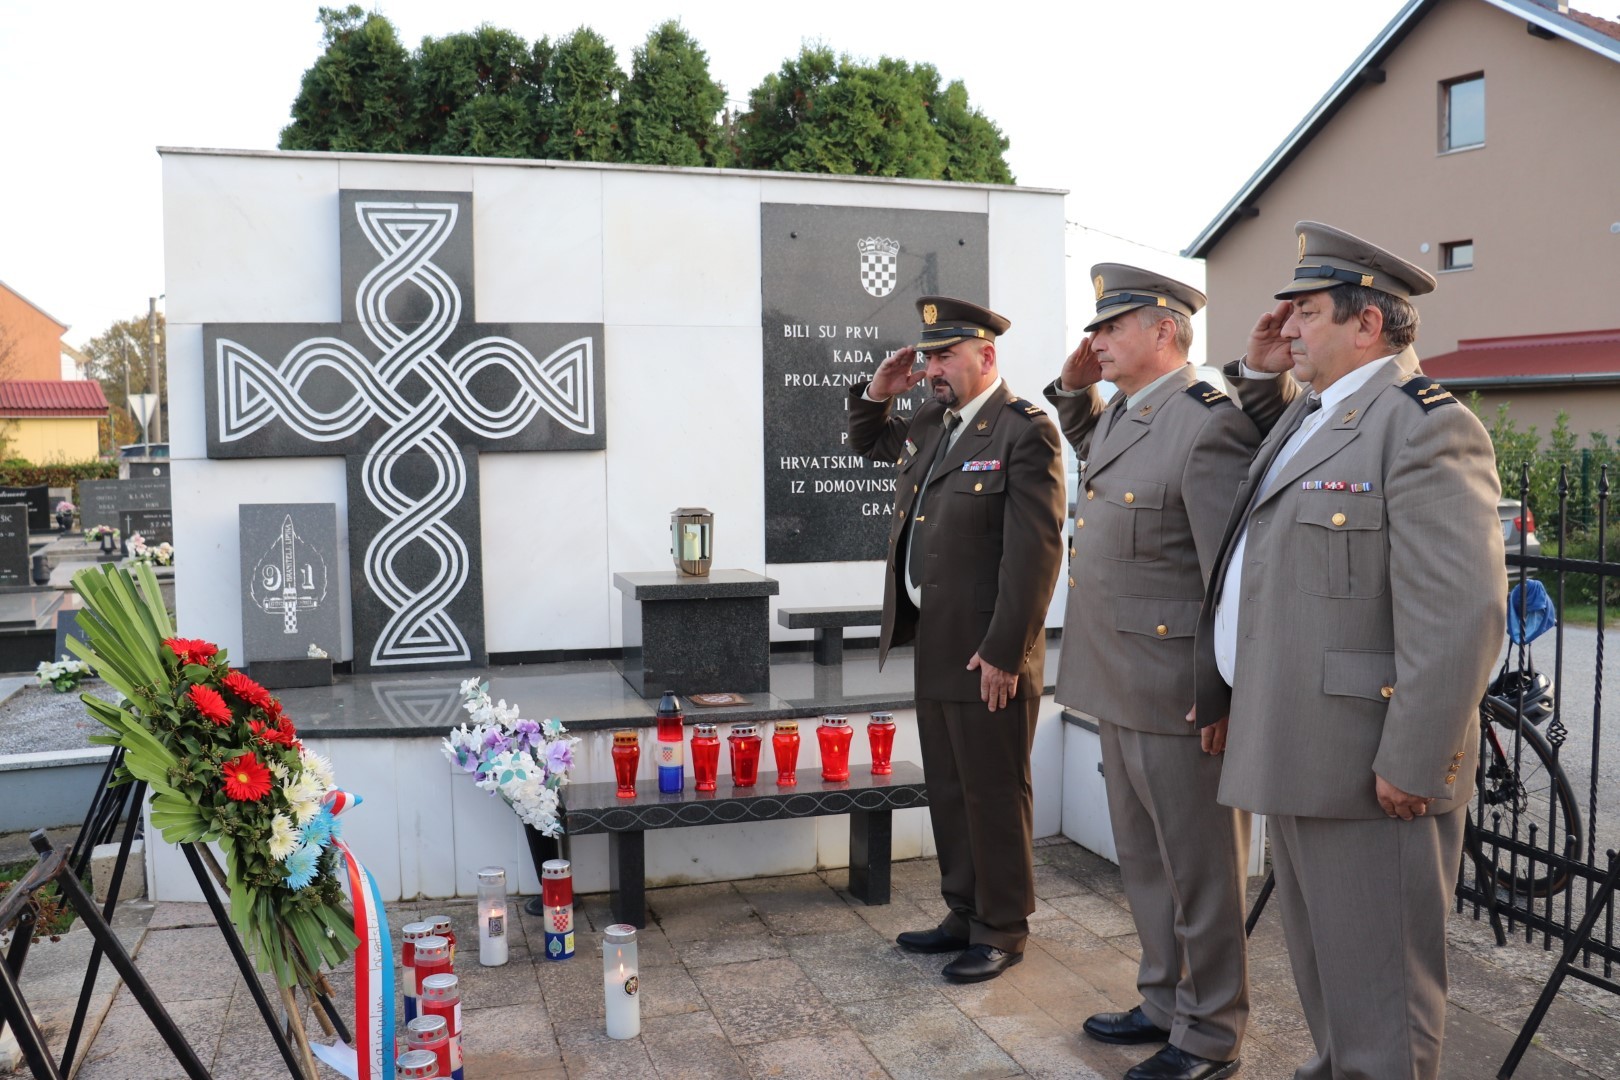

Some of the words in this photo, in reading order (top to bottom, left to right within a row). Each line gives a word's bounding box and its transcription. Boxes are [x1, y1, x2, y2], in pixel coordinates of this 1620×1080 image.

[784, 324, 810, 338] BILI
[818, 325, 837, 338] SU
[846, 326, 879, 339] PRVI
[833, 350, 874, 363] KADA
[780, 455, 864, 470] HRVATSKIM
[791, 481, 805, 494] IZ
[815, 479, 897, 494] DOMOVINSK
